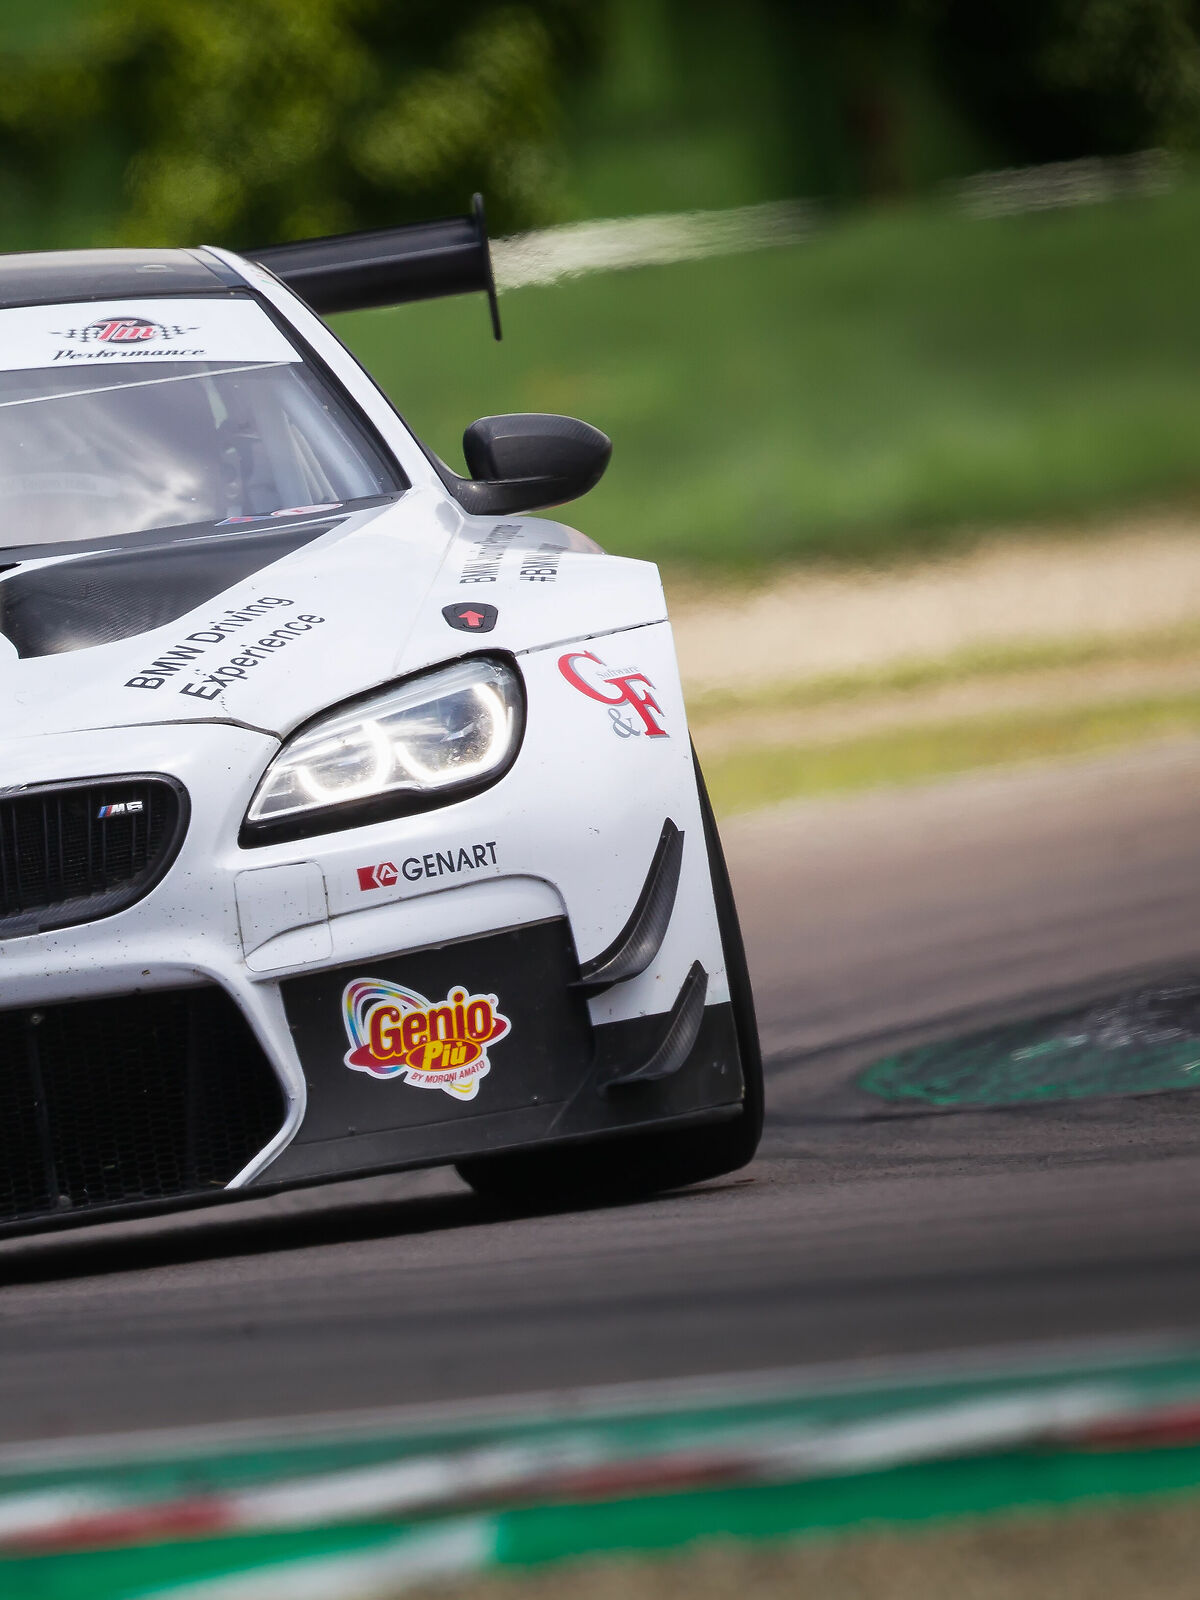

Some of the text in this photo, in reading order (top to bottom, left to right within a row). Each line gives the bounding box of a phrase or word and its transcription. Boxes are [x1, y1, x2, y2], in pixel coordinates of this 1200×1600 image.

[52, 349, 207, 361] Performance
[123, 596, 296, 690] BMW Driving
[178, 612, 326, 701] Experience
[107, 801, 143, 817] M6
[402, 841, 497, 881] GENART
[369, 992, 494, 1060] Genio
[410, 1060, 486, 1083] BY MORONI AMATO
